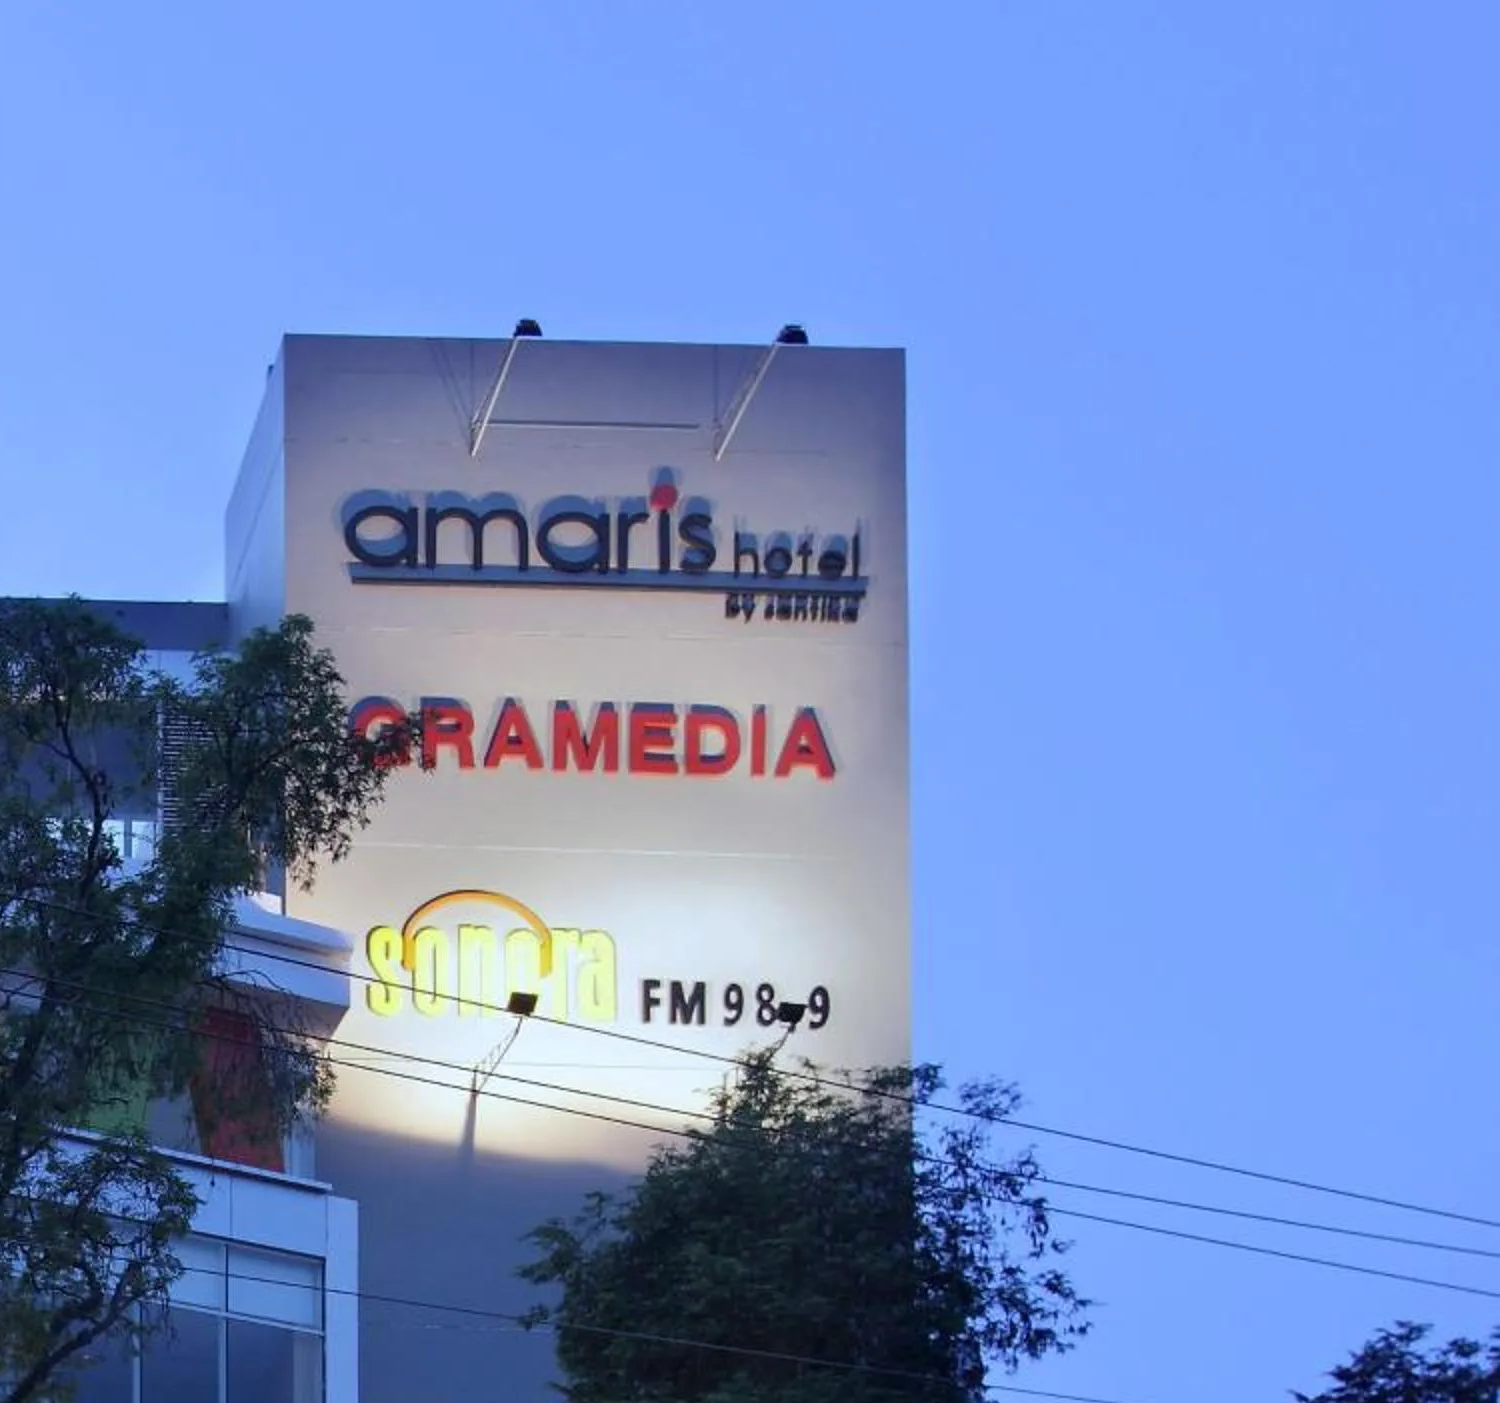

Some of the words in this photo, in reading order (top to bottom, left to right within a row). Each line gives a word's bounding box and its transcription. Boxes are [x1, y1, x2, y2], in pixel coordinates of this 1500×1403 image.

[341, 482, 717, 574] amaris
[732, 530, 861, 580] hotel
[641, 979, 706, 1025] FM
[724, 983, 831, 1029] 989
